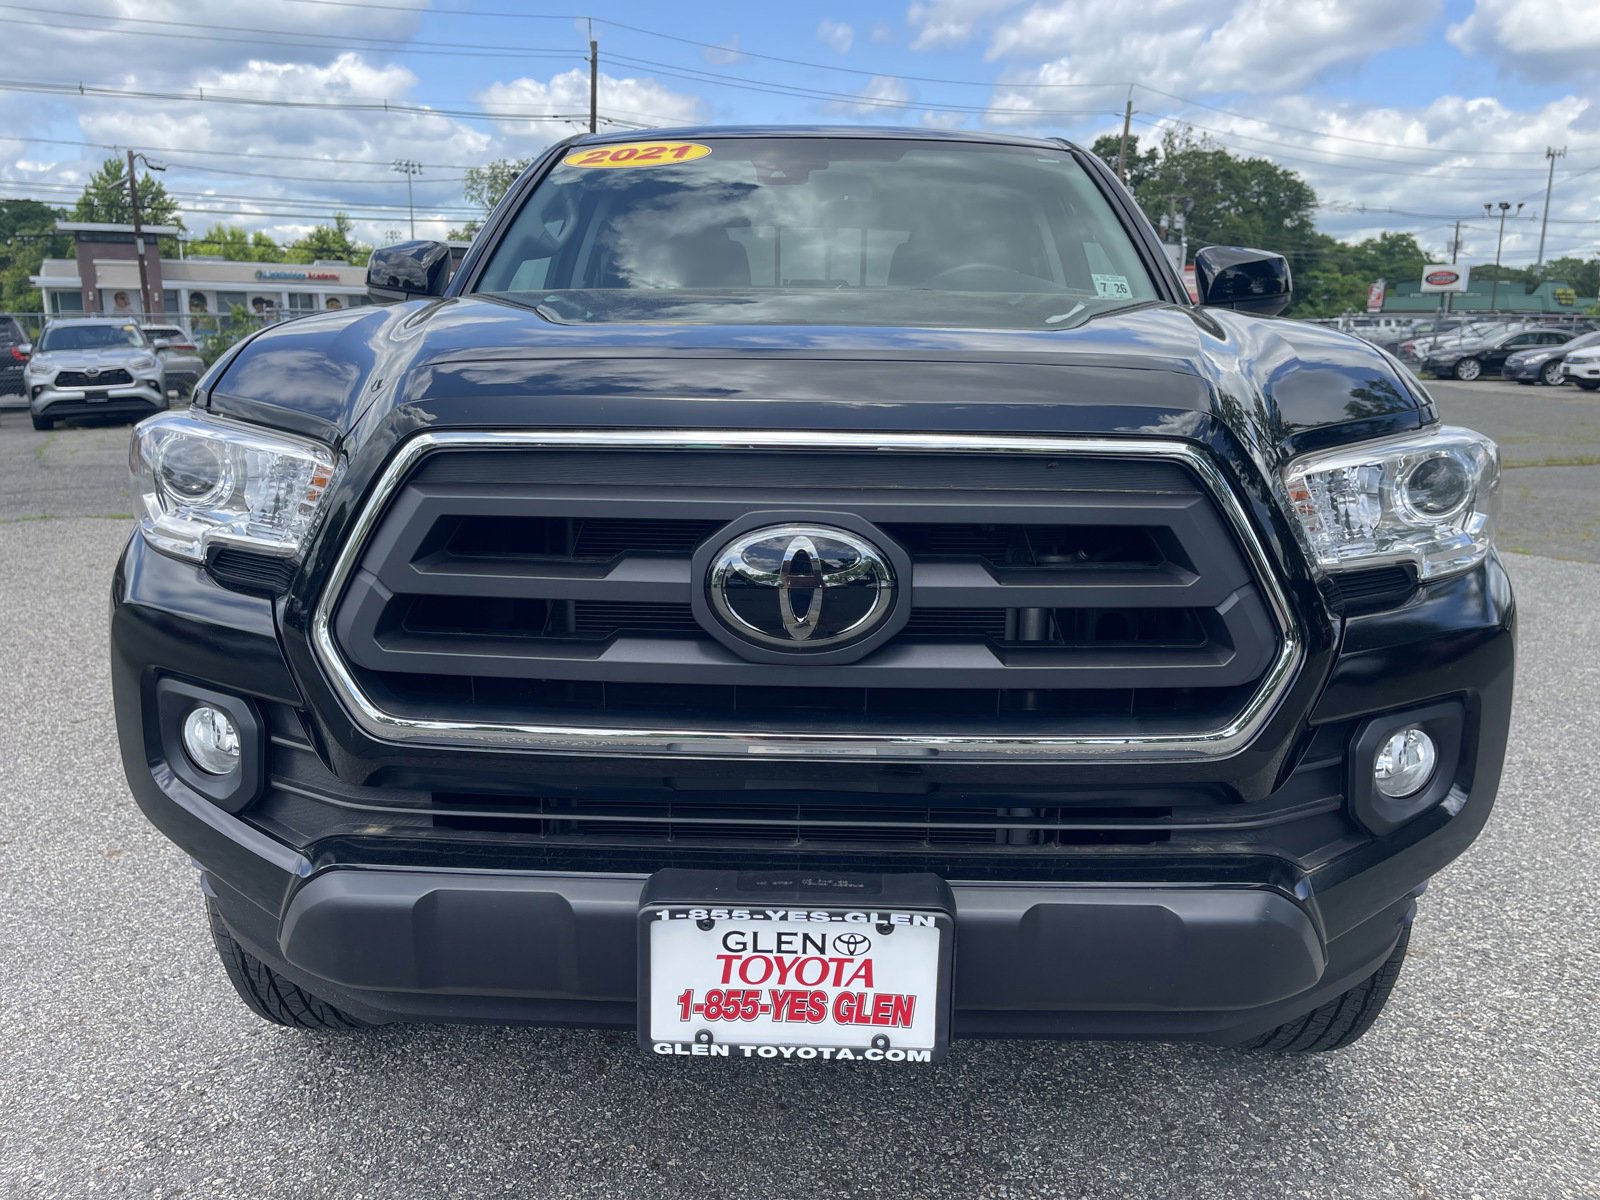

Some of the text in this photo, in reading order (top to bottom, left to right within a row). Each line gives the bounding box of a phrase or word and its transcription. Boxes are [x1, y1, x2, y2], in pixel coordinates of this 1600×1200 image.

[577, 145, 692, 165] 2021
[1100, 282, 1128, 294] 7 26
[656, 909, 936, 928] 1-855-YES-GLEN
[721, 930, 827, 955] GLEN
[716, 954, 876, 988] TOYOTA
[677, 989, 917, 1029] 1-855-YES GLEN
[653, 1042, 932, 1062] GLEN TOYOTA.COM
